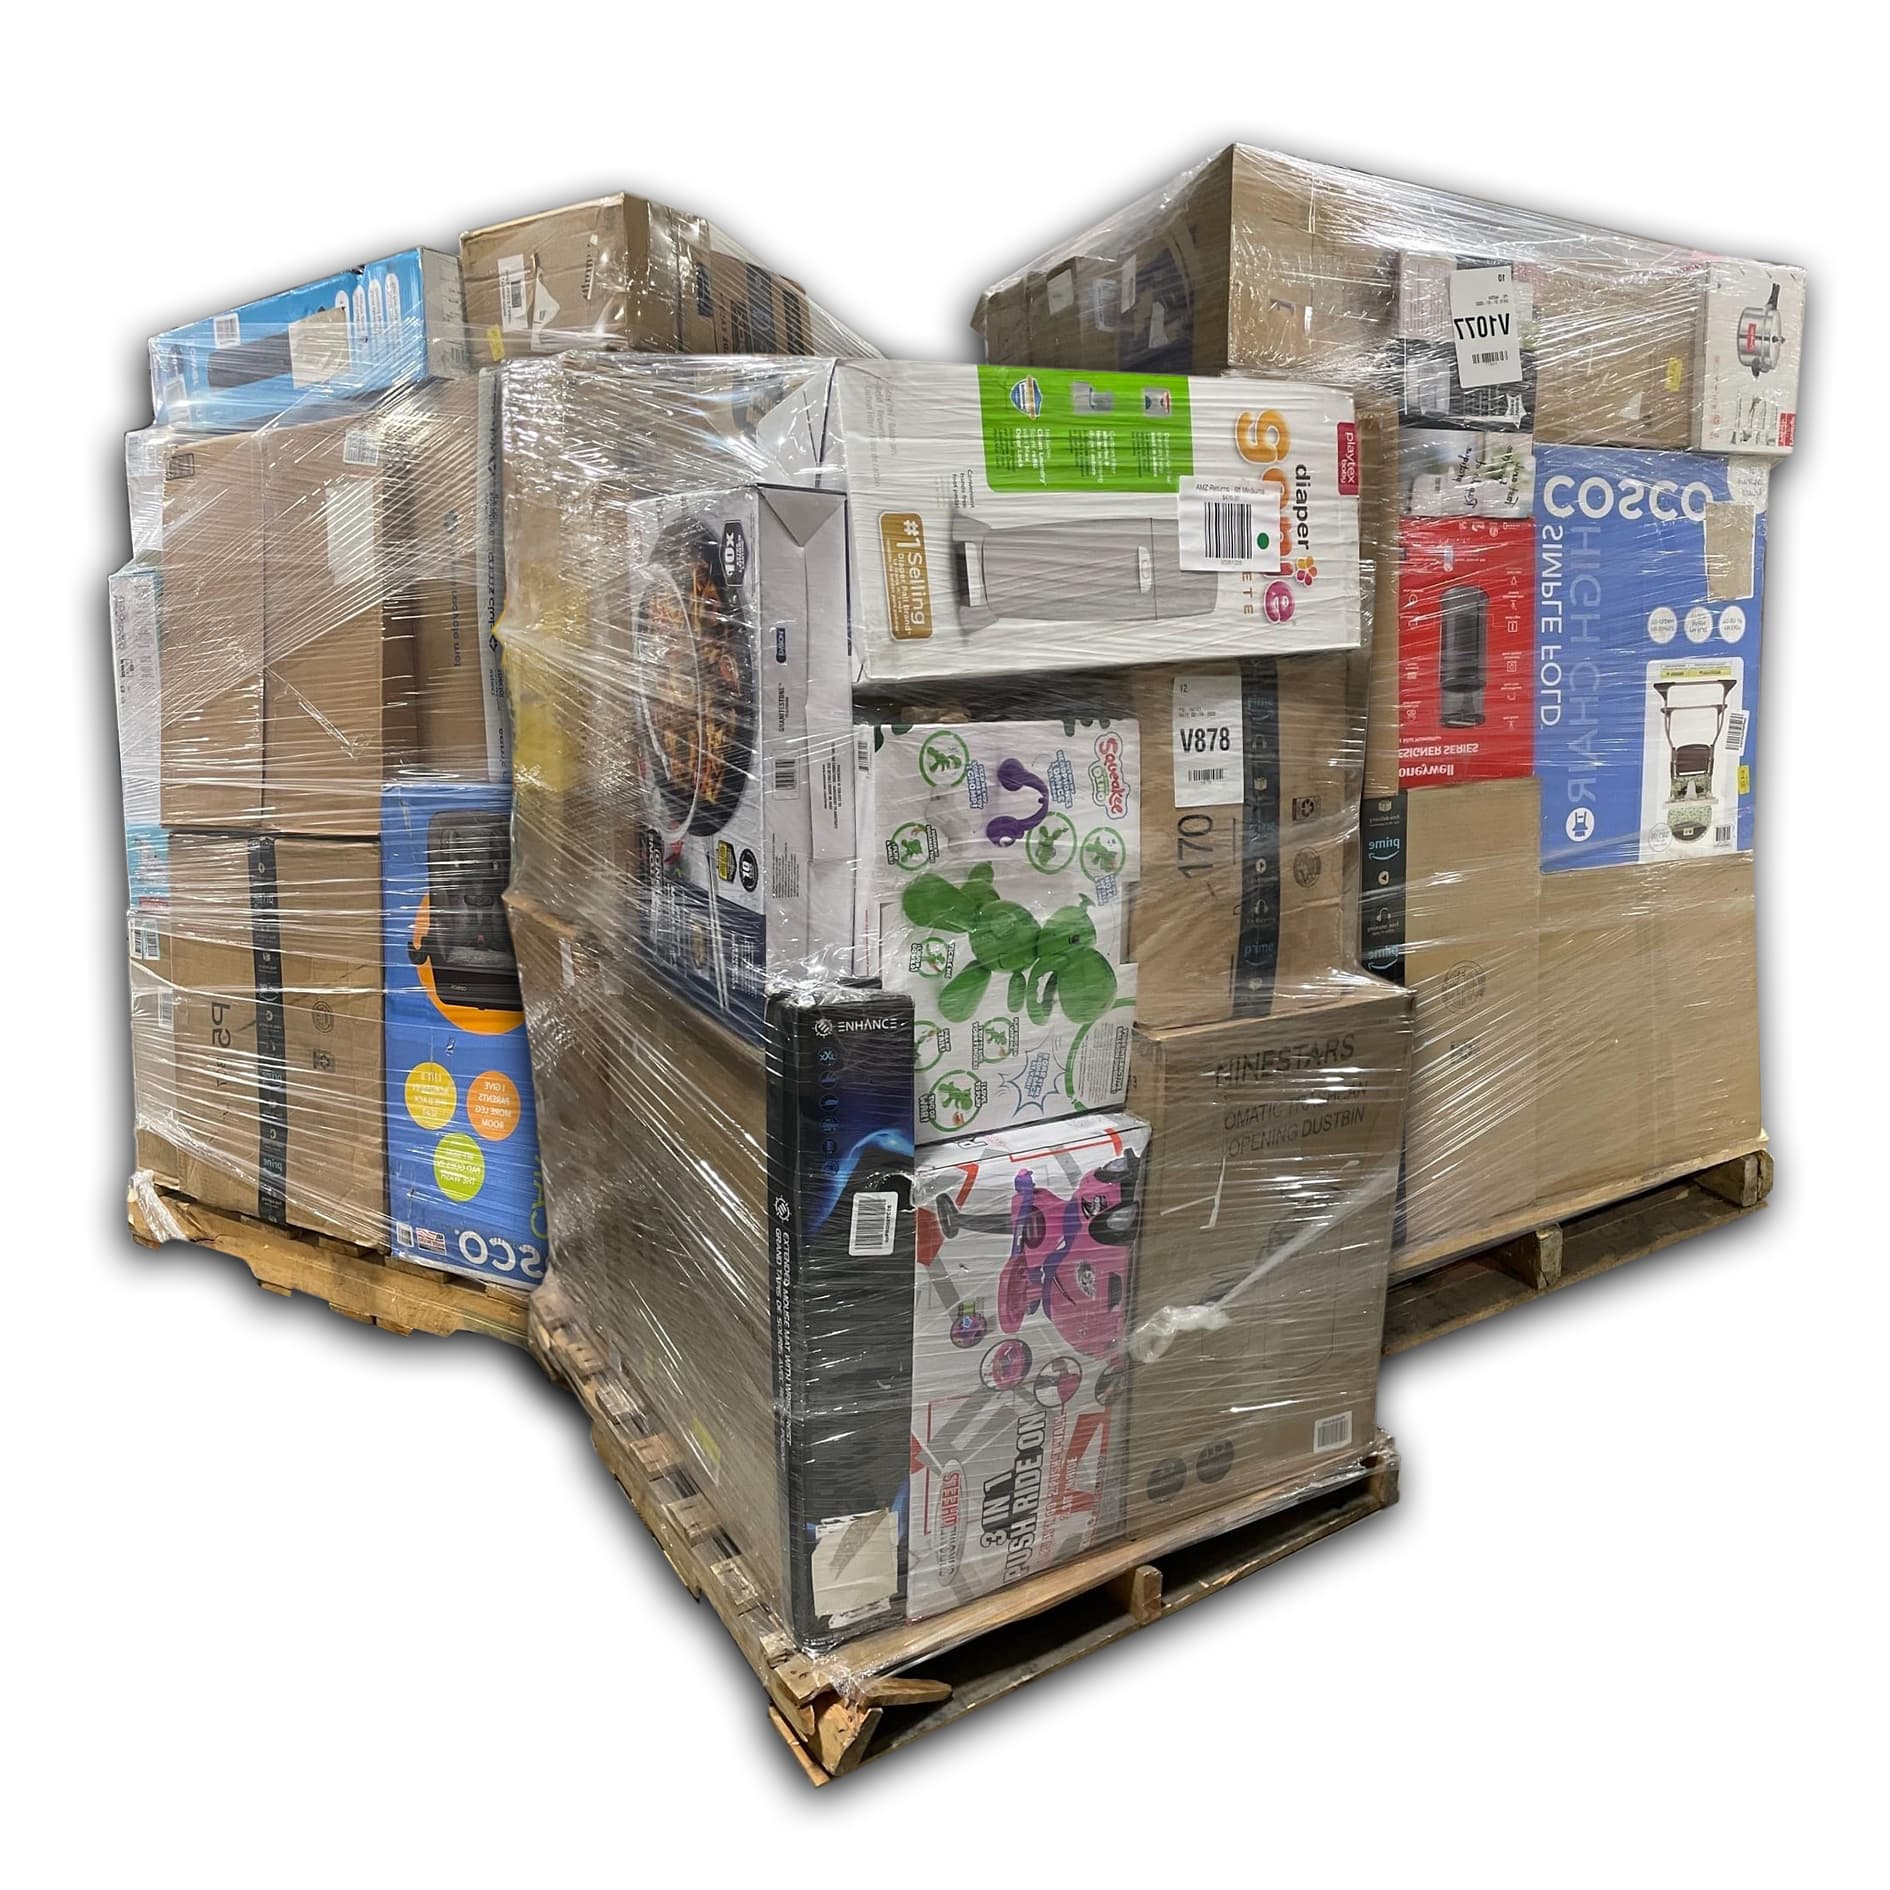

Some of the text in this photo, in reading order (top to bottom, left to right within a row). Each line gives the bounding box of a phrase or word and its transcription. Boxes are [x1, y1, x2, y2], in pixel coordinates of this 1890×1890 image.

[1345, 432, 1357, 483] playtex
[1293, 464, 1310, 550] diaper
[725, 532, 734, 576] 10X
[896, 520, 926, 625] #1 Selling
[898, 553, 906, 584] Diaper
[1180, 727, 1230, 752] V878
[967, 770, 978, 808] CHOMP!
[1053, 768, 1064, 802] DANCE
[1057, 751, 1071, 808] HEADPHONES
[1099, 738, 1125, 814] Squeakee
[743, 861, 749, 878] 10
[838, 1017, 897, 1033] ENHANCE
[1215, 1034, 1355, 1089] NINESTARS
[975, 1082, 979, 1090] TO
[920, 1095, 929, 1122] WAR!
[930, 1110, 935, 1120] OF
[1228, 1106, 1366, 1157] OPENING DUSTBIN
[782, 1232, 791, 1286] EXTENDED
[776, 1299, 782, 1314] DE
[782, 1288, 790, 1328] MOUSE
[776, 1316, 784, 1353] SOURIS
[783, 1330, 791, 1353] MAT
[784, 1355, 792, 1381] WITH
[980, 1471, 1013, 1548] 3 IN 1
[1004, 1411, 1046, 1582] PUSH RIDE ON
